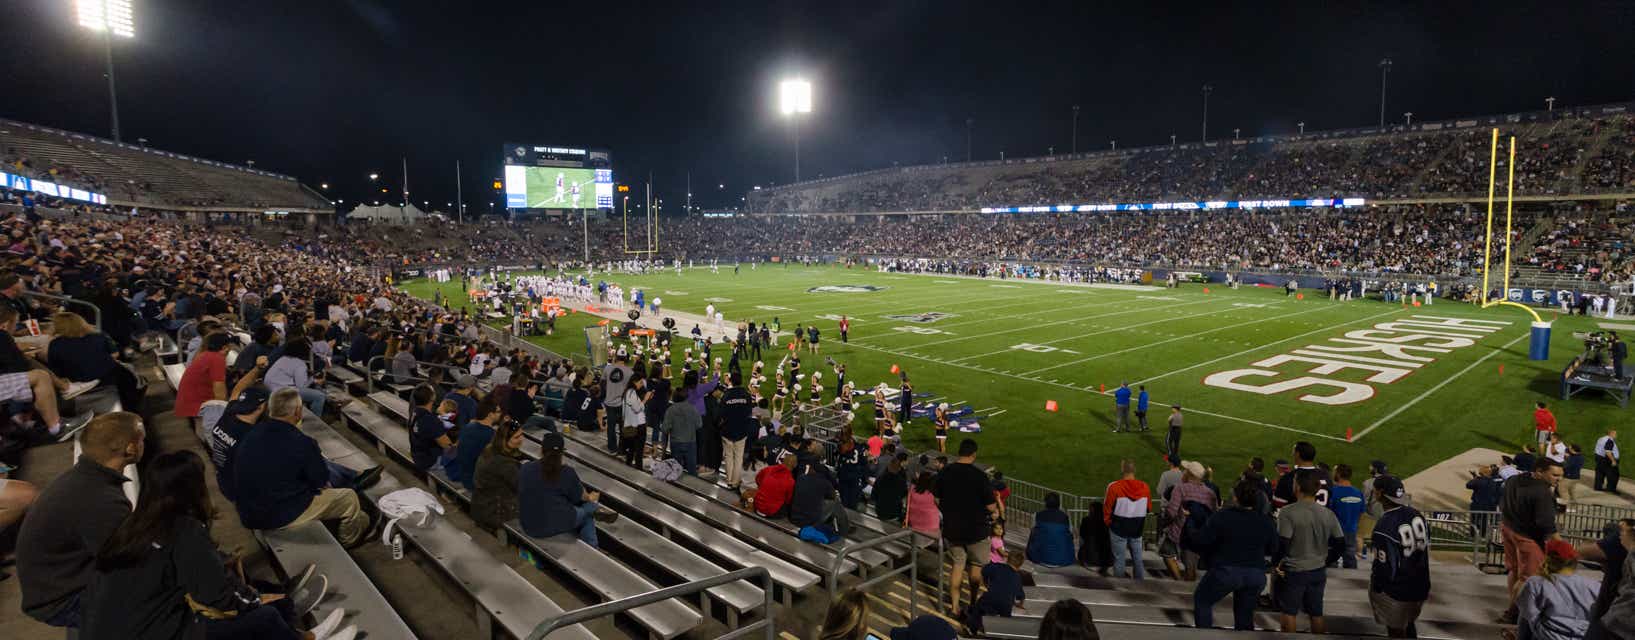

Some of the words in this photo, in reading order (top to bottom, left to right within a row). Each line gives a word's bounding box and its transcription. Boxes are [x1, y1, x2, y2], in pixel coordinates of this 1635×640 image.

[1263, 200, 1290, 208] DOWN
[1202, 315, 1513, 406] HUSKIES
[581, 397, 590, 410] 6
[213, 426, 237, 447] UCONN
[1398, 516, 1427, 557] 99
